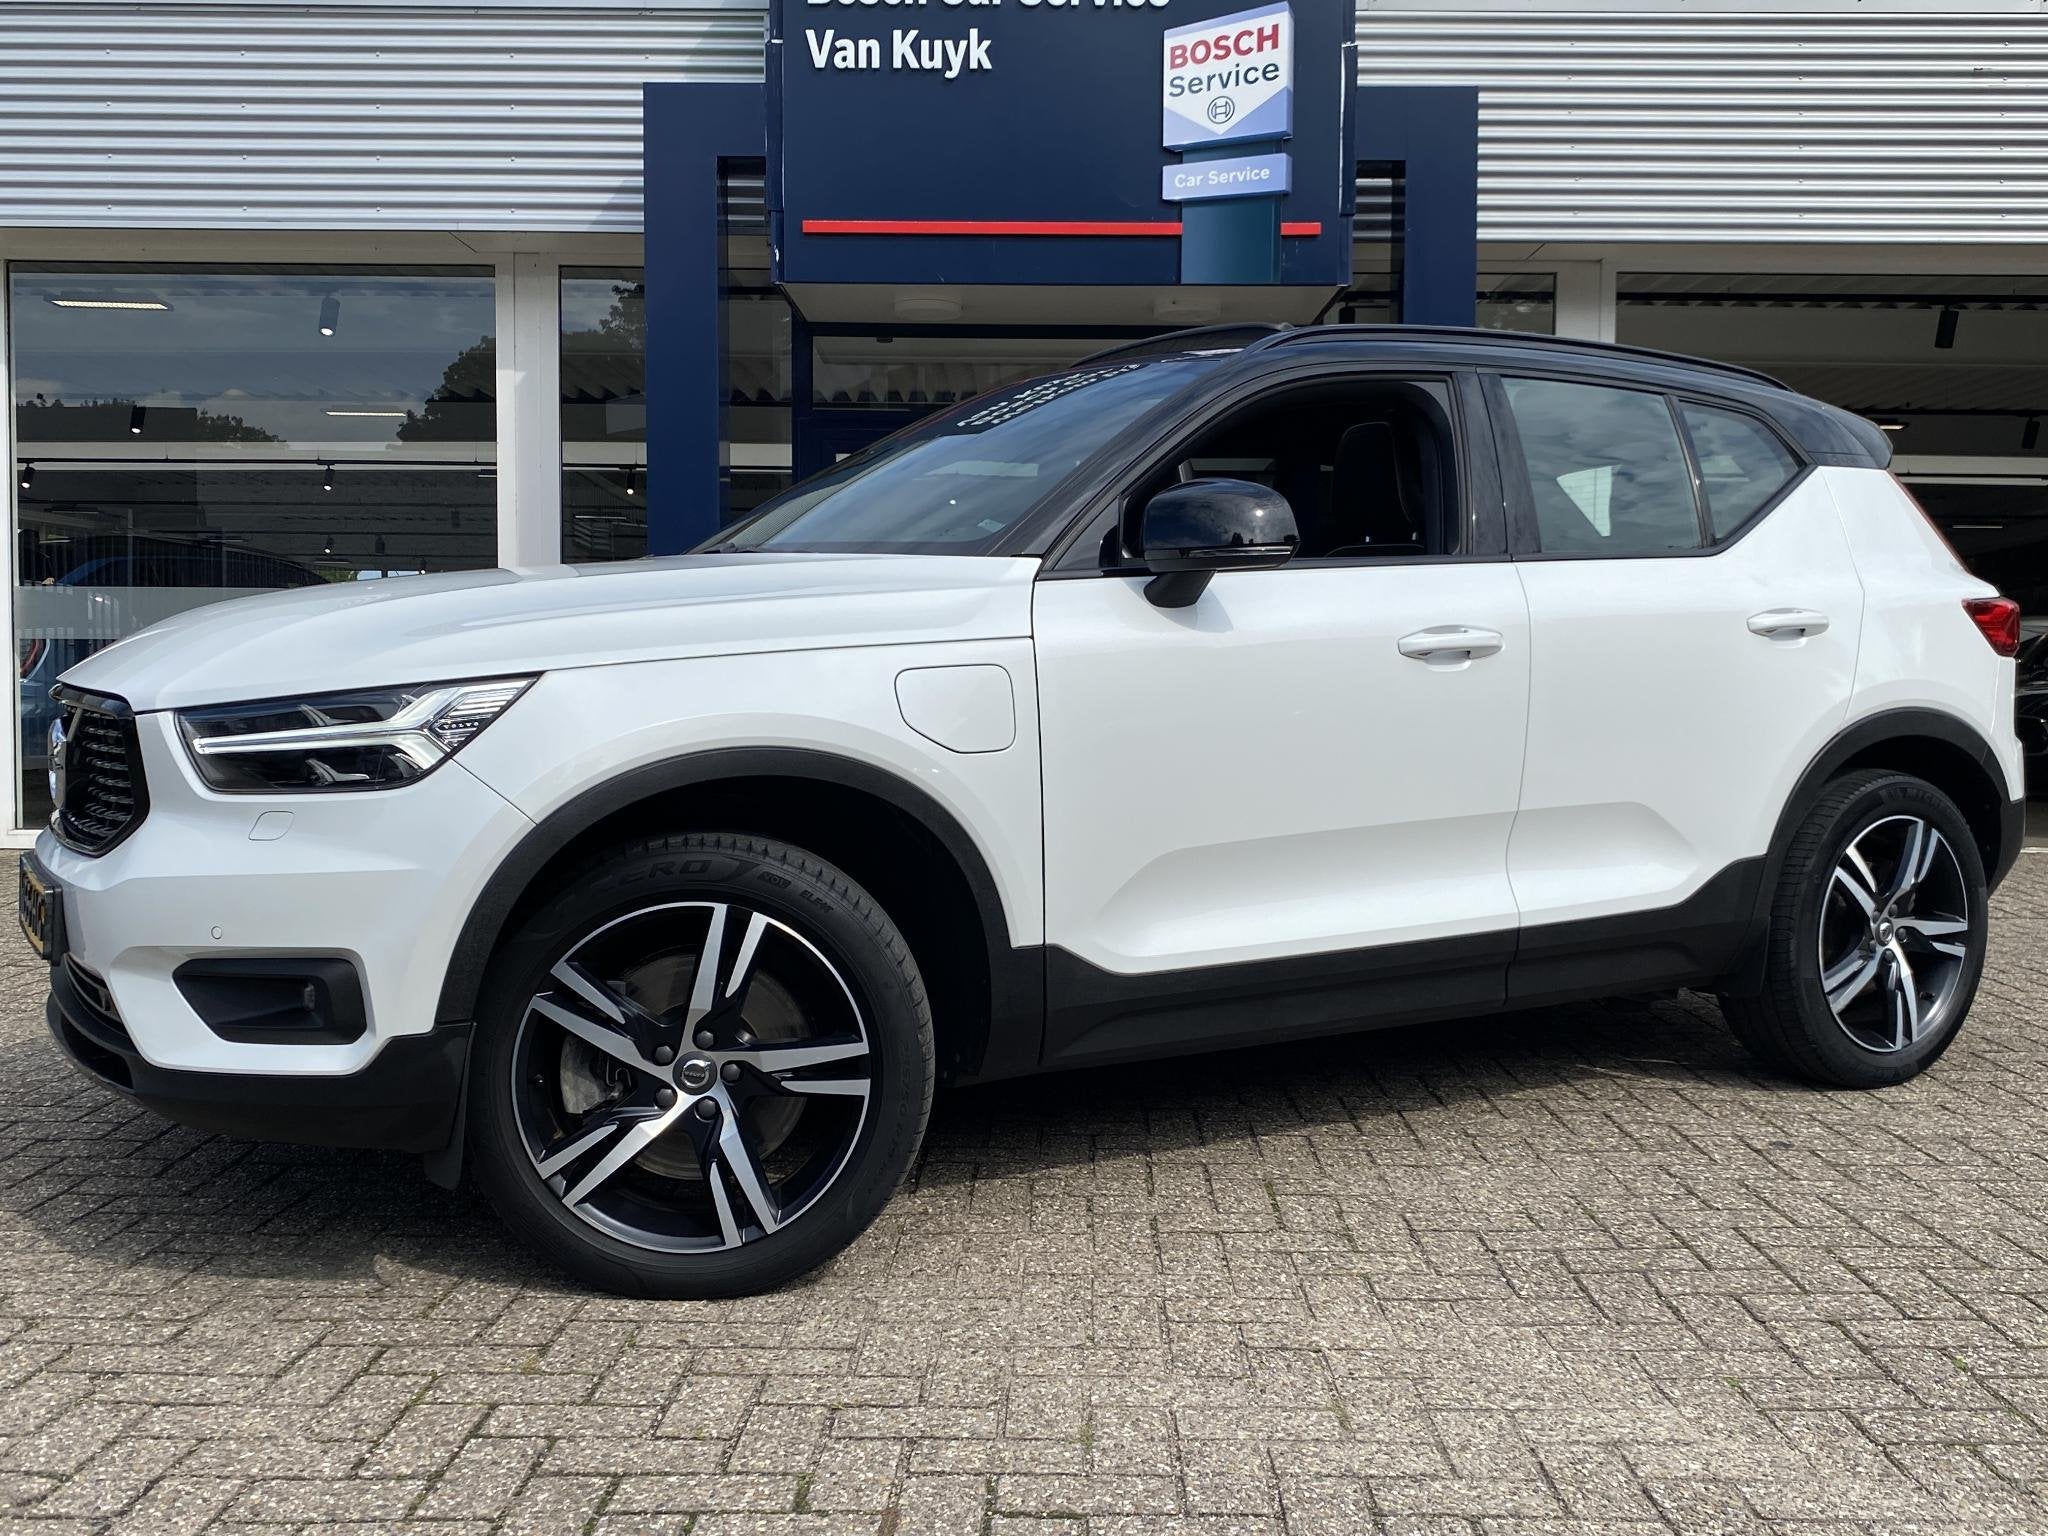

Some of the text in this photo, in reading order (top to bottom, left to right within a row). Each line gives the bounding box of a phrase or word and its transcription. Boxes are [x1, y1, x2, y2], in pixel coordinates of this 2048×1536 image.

[805, 28, 992, 79] Van Kuyk
[1170, 23, 1279, 70] BOSCH
[1169, 62, 1280, 97] Service
[1174, 167, 1270, 188] Car Service
